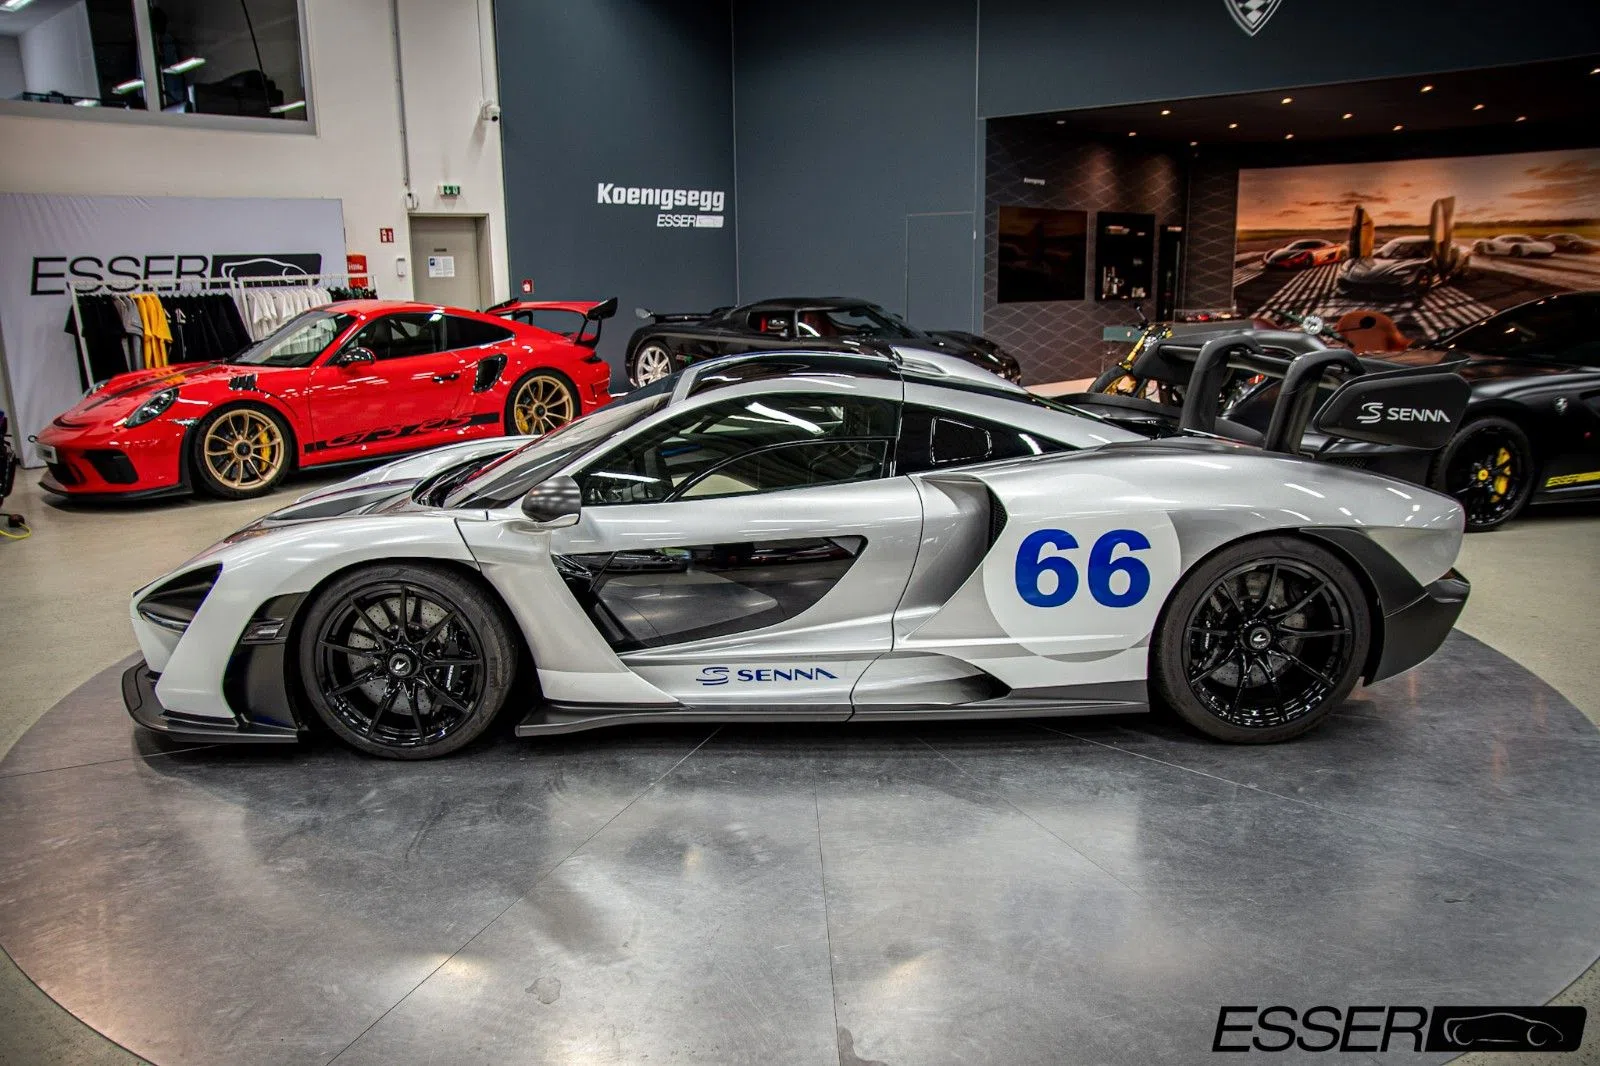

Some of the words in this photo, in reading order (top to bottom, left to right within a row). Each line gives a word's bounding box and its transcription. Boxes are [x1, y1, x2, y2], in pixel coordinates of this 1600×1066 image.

[597, 183, 725, 212] Koenigsegg
[656, 214, 697, 228] ESSER
[30, 254, 209, 296] ESSER
[1386, 407, 1451, 423] SENNA
[1014, 528, 1152, 608] 66
[737, 667, 840, 682] SENNA
